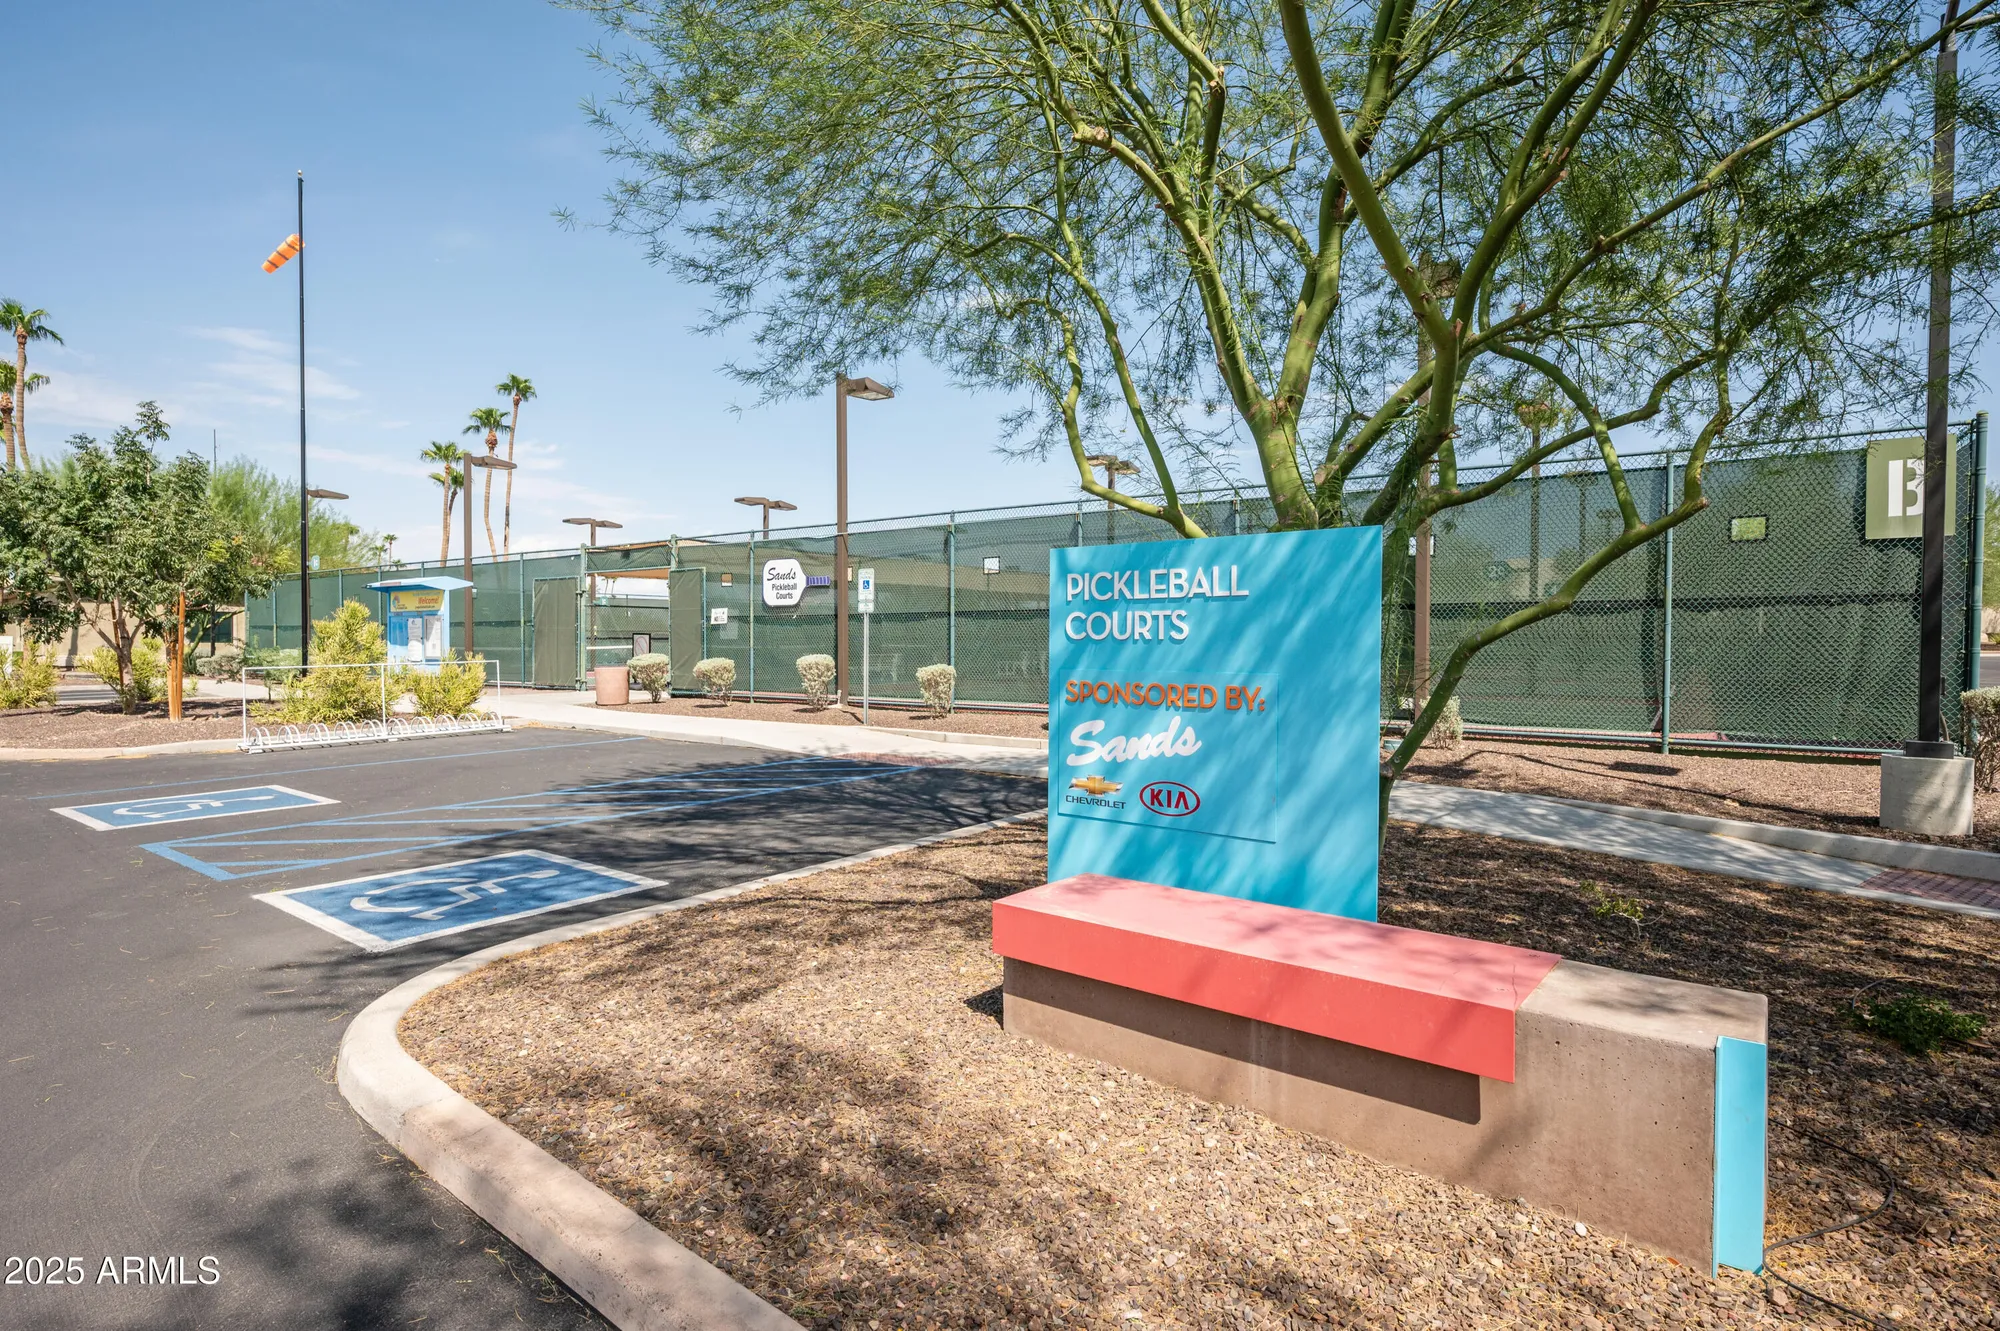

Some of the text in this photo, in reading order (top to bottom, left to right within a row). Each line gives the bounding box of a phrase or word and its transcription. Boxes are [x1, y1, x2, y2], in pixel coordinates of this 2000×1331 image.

[767, 567, 796, 581] Sands
[1066, 564, 1250, 601] PICKLEBALL
[772, 583, 798, 591] Pickleball
[775, 592, 794, 600] Courts
[1065, 609, 1189, 641] COURTS
[1065, 680, 1266, 711] SPONSORED BY:
[1066, 715, 1202, 767] Sands
[1065, 794, 1127, 810] CHEVROLET
[1150, 787, 1190, 810] KIA
